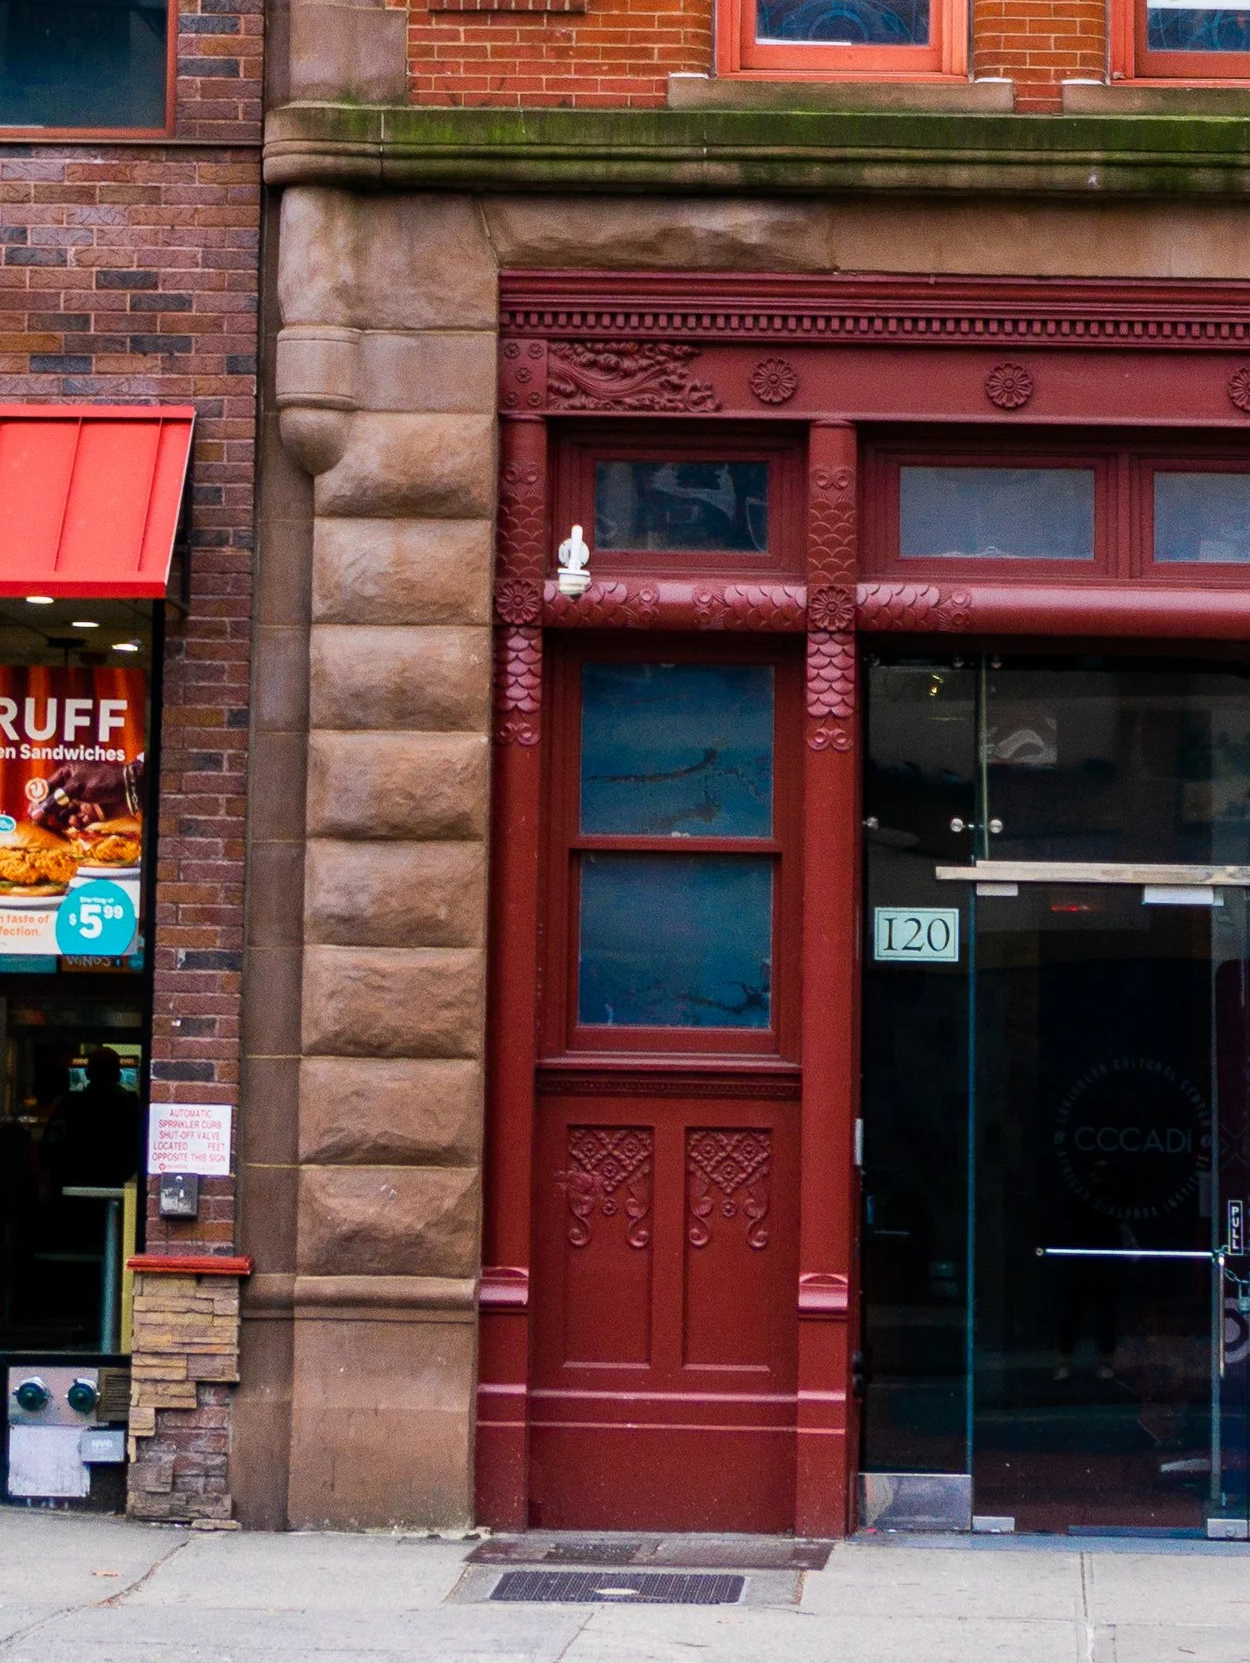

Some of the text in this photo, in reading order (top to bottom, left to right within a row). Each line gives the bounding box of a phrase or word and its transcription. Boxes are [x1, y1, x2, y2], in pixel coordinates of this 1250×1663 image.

[20, 744, 126, 761] Sandwiches
[7, 914, 34, 924] taste
[38, 914, 49, 924] of
[884, 916, 951, 953] 120
[169, 1109, 212, 1118] AUTOMATIC
[159, 1119, 222, 1129] SPRINKLER CURB
[159, 1130, 221, 1141] SHUT-OFF VALVE
[1074, 1125, 1193, 1154] CCCADI
[153, 1141, 225, 1151] LOCATED FEET
[152, 1152, 226, 1163] OPPOSITE THIS SIGN
[1231, 1206, 1240, 1250] PULL
